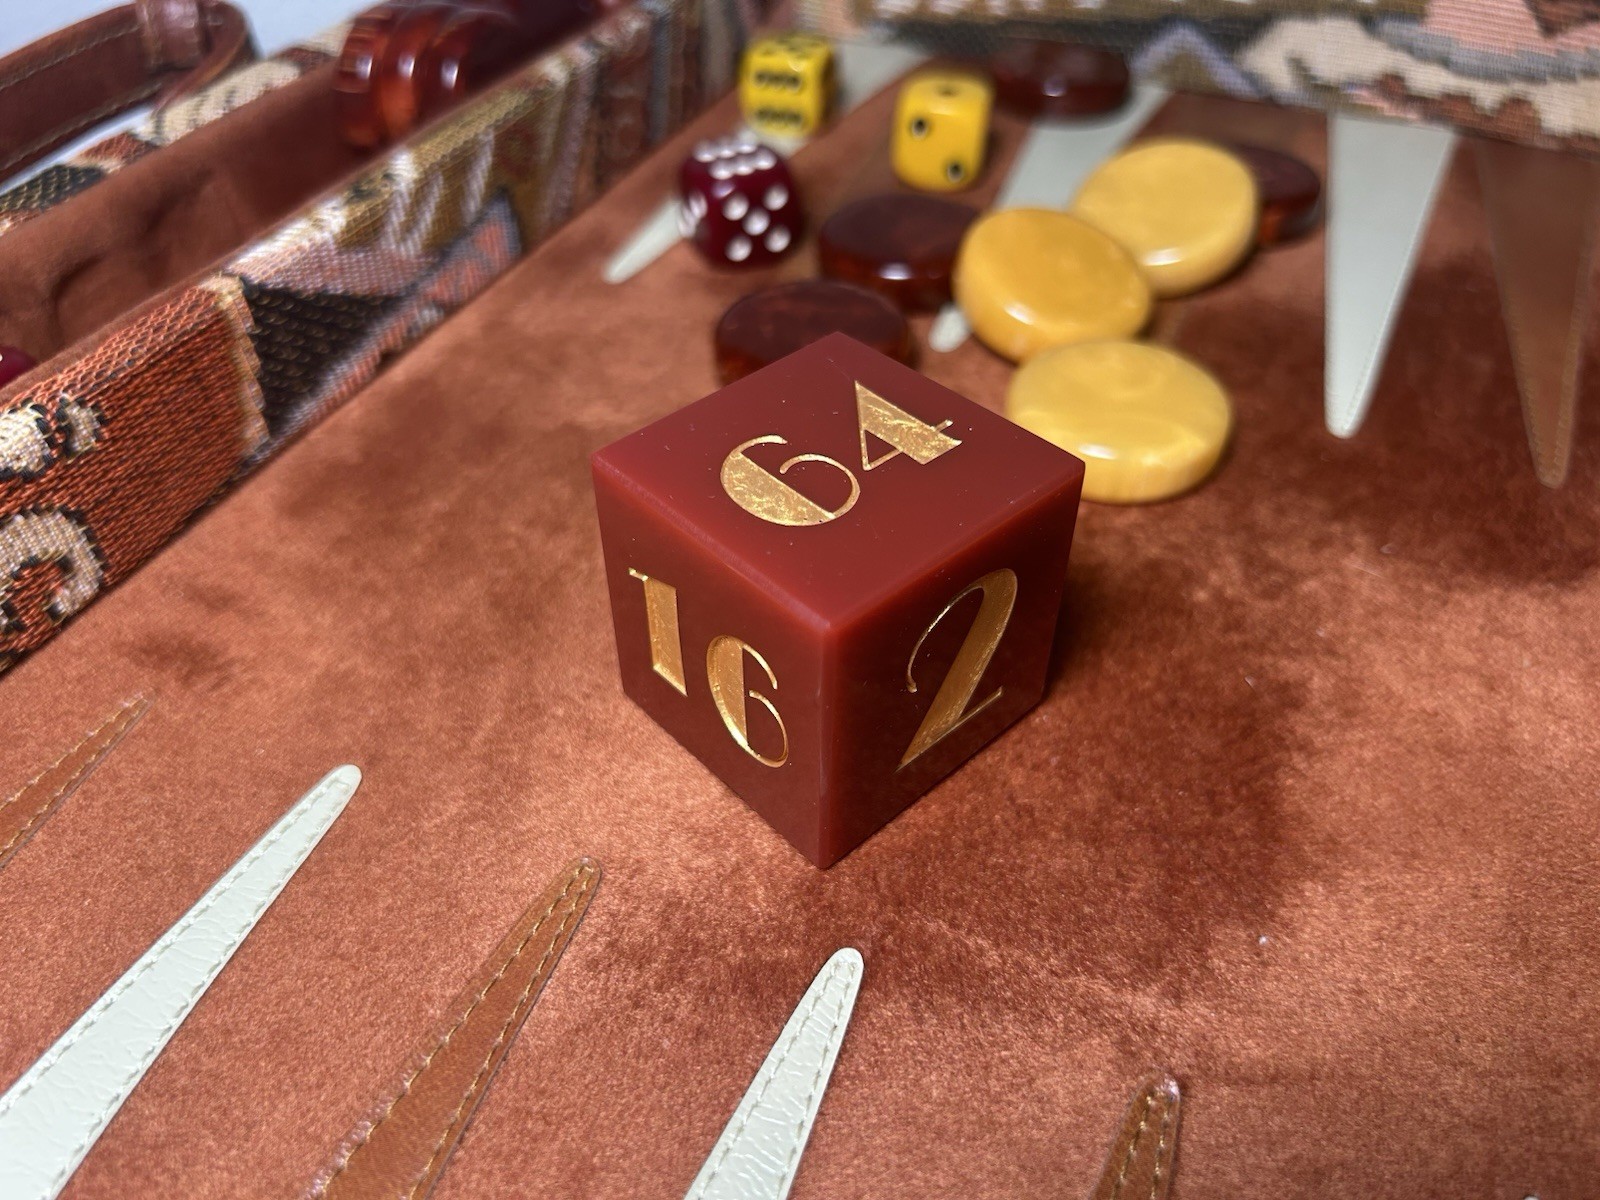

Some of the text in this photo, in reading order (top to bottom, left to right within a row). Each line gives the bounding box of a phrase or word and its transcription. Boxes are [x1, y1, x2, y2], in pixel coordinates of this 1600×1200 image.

[720, 380, 962, 527] 64
[628, 567, 790, 768] 16
[895, 567, 1018, 773] 2
